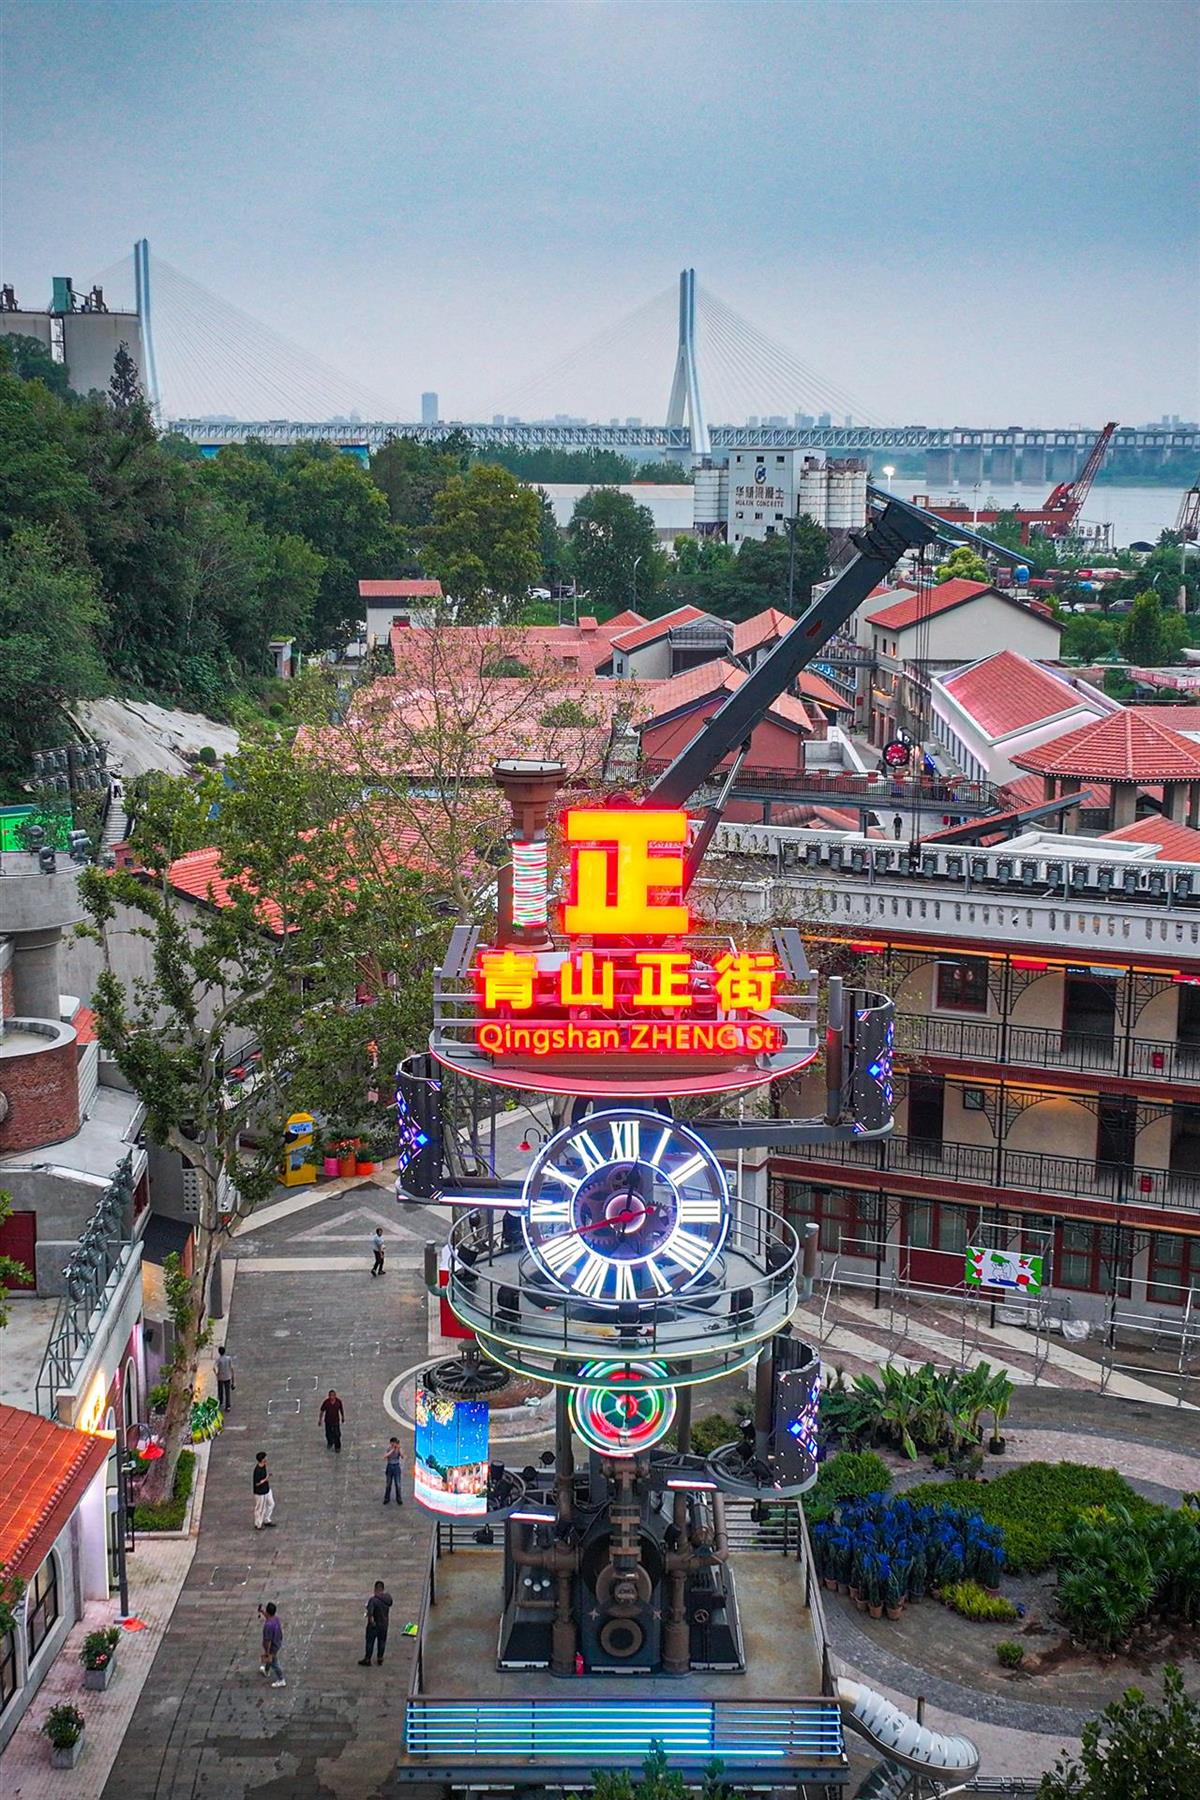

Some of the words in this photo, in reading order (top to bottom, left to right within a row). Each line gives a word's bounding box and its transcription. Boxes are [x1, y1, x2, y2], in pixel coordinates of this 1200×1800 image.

[565, 811, 688, 933] 正
[481, 951, 777, 1011] 青山正街
[480, 1023, 619, 1053] Qingshan
[631, 1025, 737, 1049] ZHENG
[609, 1120, 640, 1160] XII
